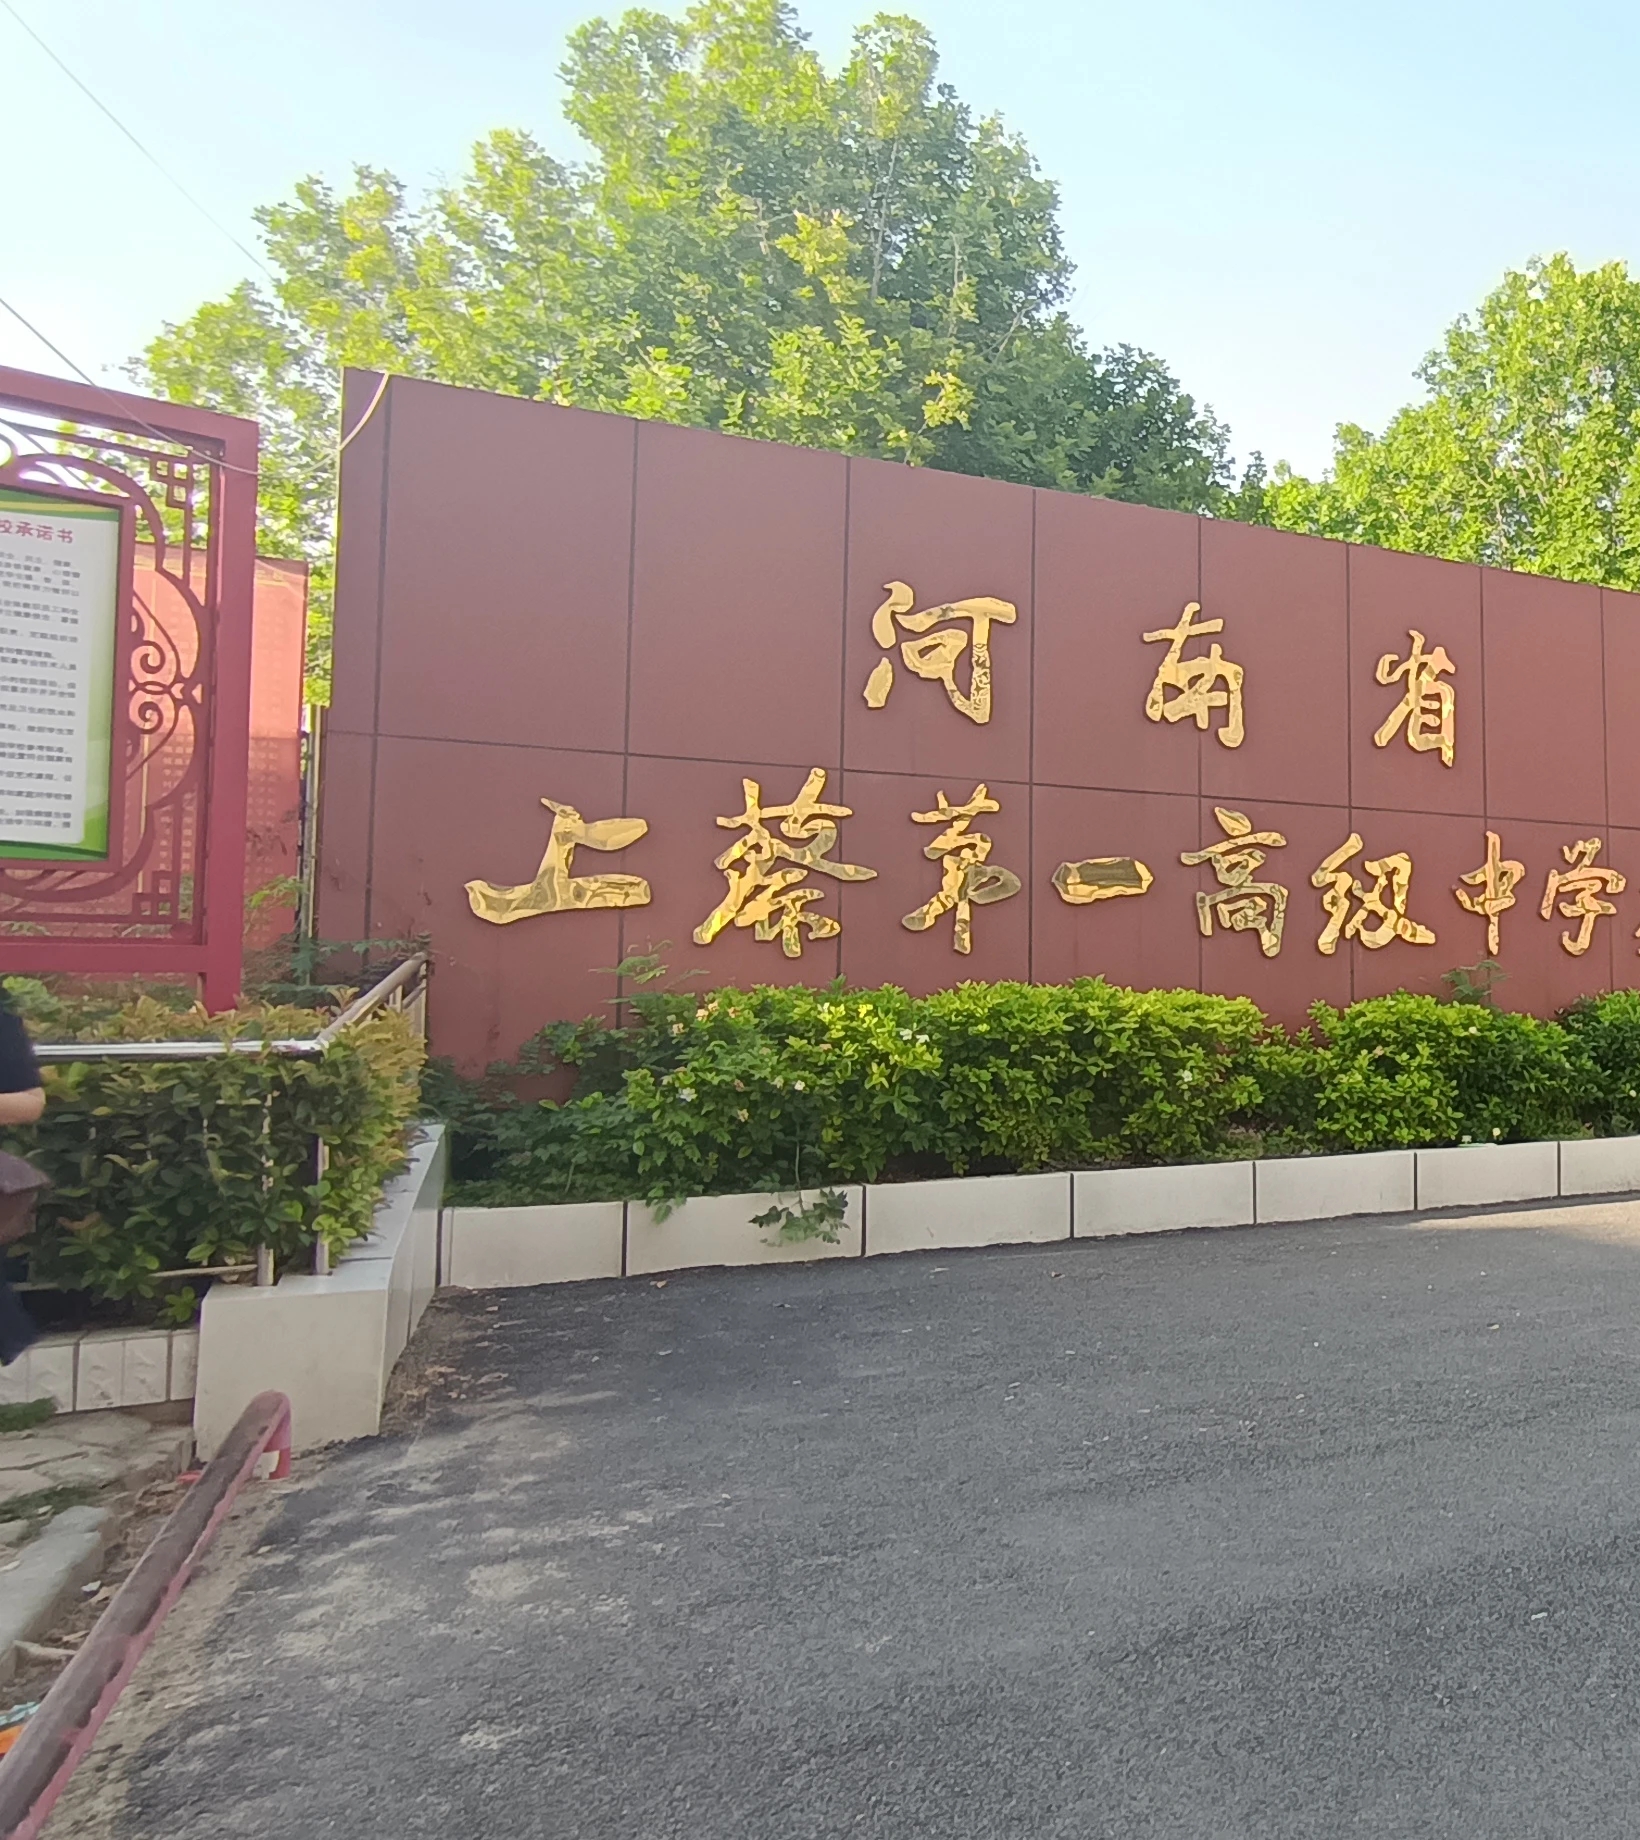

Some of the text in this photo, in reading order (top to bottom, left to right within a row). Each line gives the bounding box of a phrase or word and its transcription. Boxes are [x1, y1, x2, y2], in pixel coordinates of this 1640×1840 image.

[861, 580, 1461, 768] 河南省
[464, 766, 1627, 957] 上蔡第一高级中学
